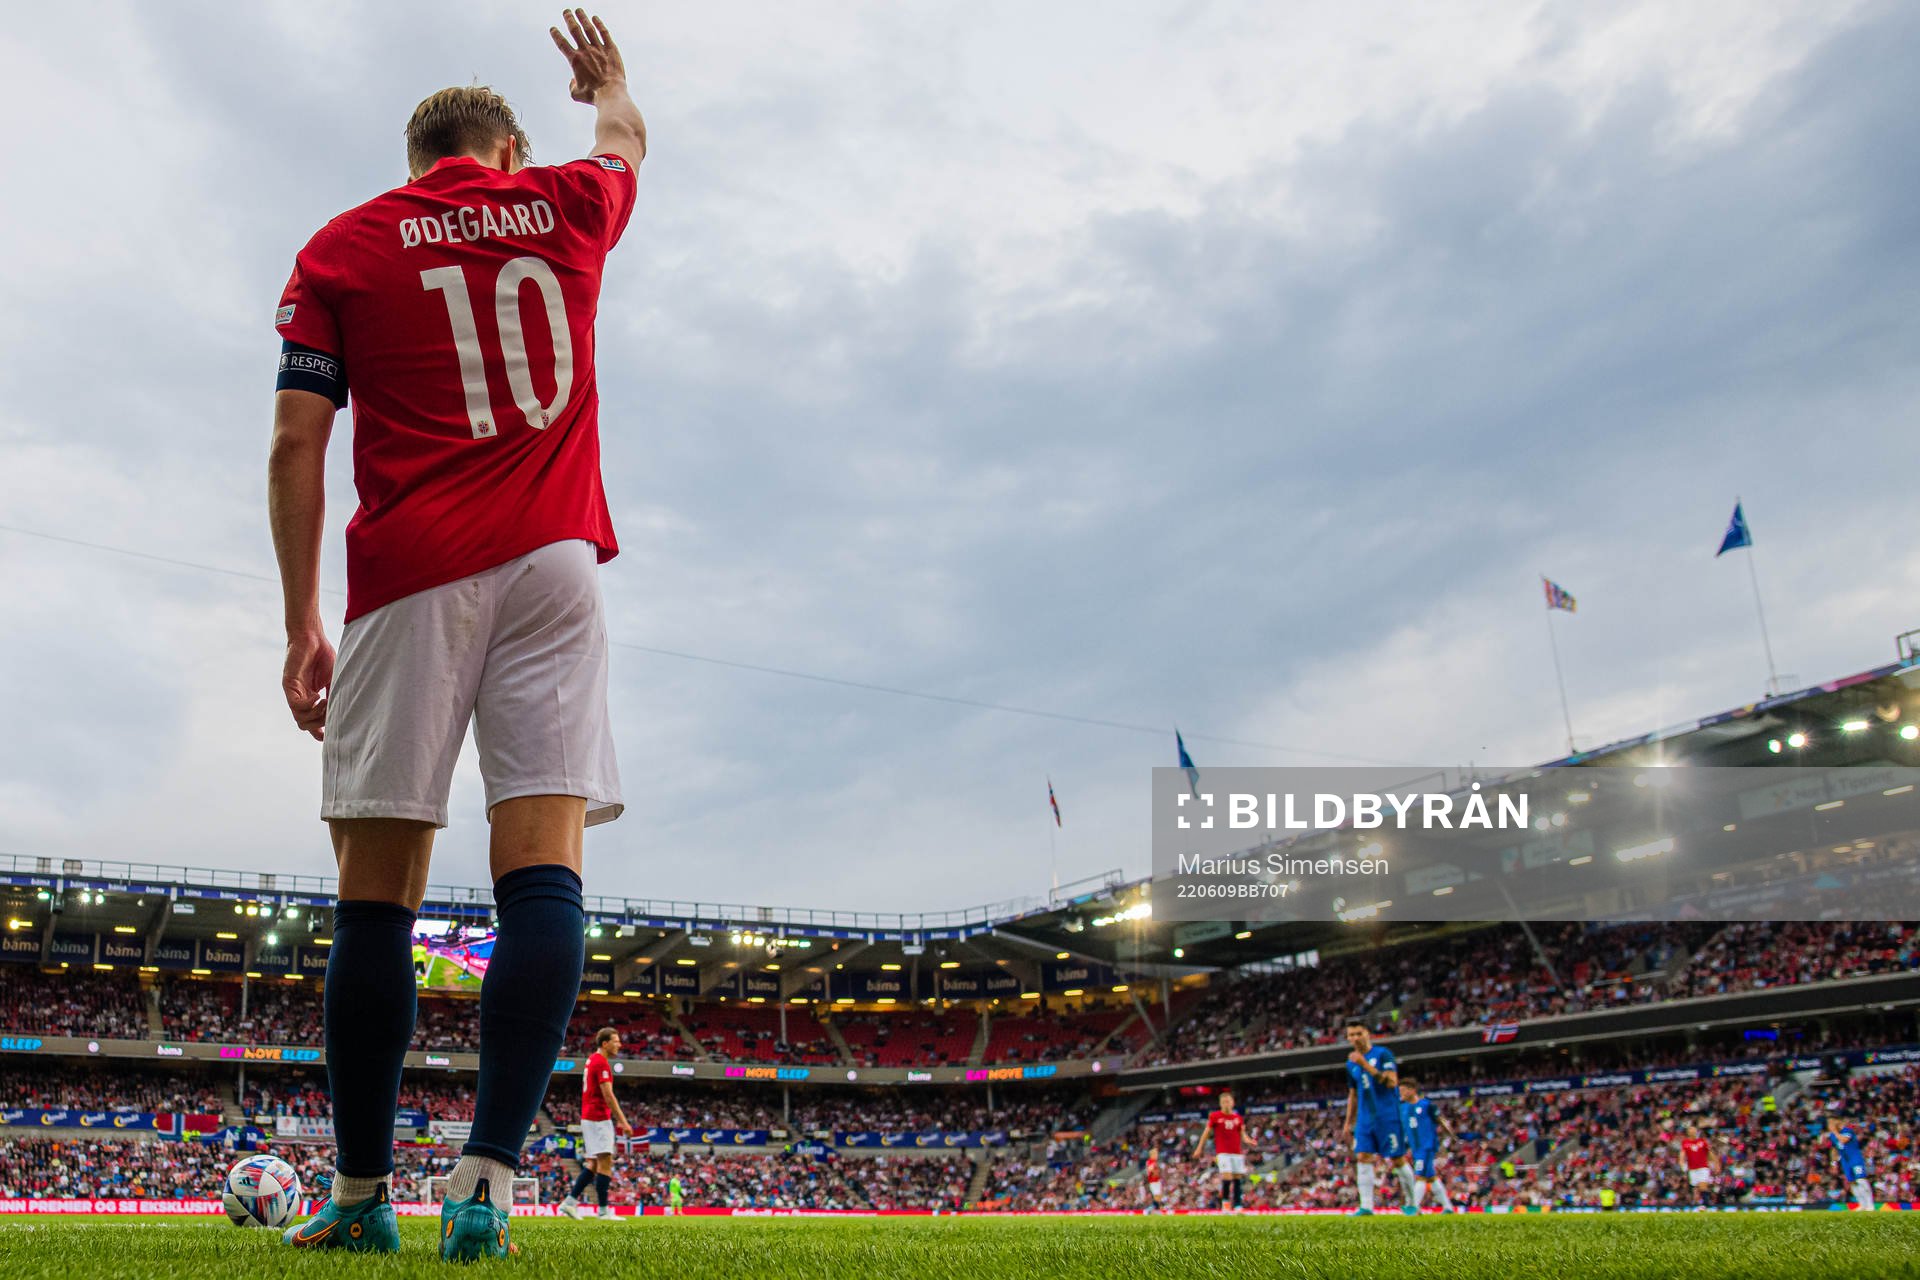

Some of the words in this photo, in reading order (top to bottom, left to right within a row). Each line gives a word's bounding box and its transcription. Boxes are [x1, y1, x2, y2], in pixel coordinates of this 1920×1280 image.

[400, 199, 555, 248] ØDEGAARD
[419, 256, 574, 440] 10
[303, 955, 329, 969] bam
[1, 1037, 42, 1050] SLEEP
[219, 1047, 244, 1058] EAT
[244, 1048, 281, 1060] MOVE
[281, 1049, 320, 1061] SLEEP
[29, 1201, 92, 1213] PREMIER
[95, 1201, 116, 1213] OG
[119, 1201, 138, 1213] SE
